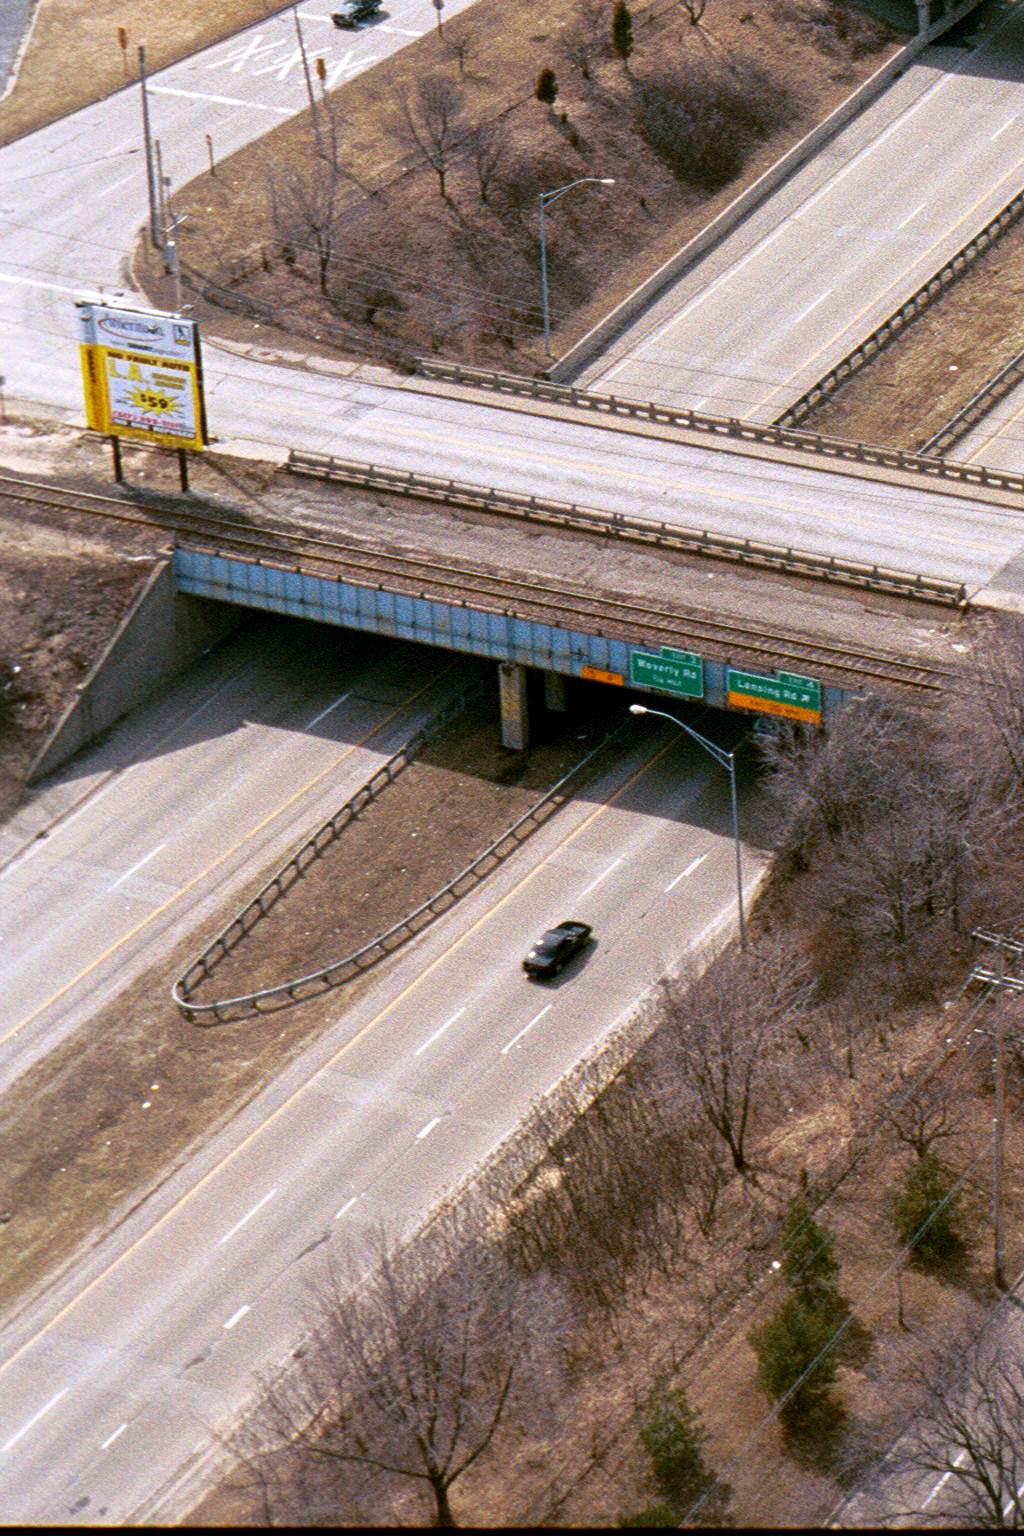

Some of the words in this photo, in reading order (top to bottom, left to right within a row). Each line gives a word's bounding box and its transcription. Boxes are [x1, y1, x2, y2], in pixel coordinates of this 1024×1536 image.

[108, 360, 151, 384] L.A.
[140, 393, 169, 409] $59
[637, 659, 680, 677] Waverly
[683, 668, 697, 680] Rd
[736, 679, 781, 698] Lansing
[783, 689, 797, 701] Rd
